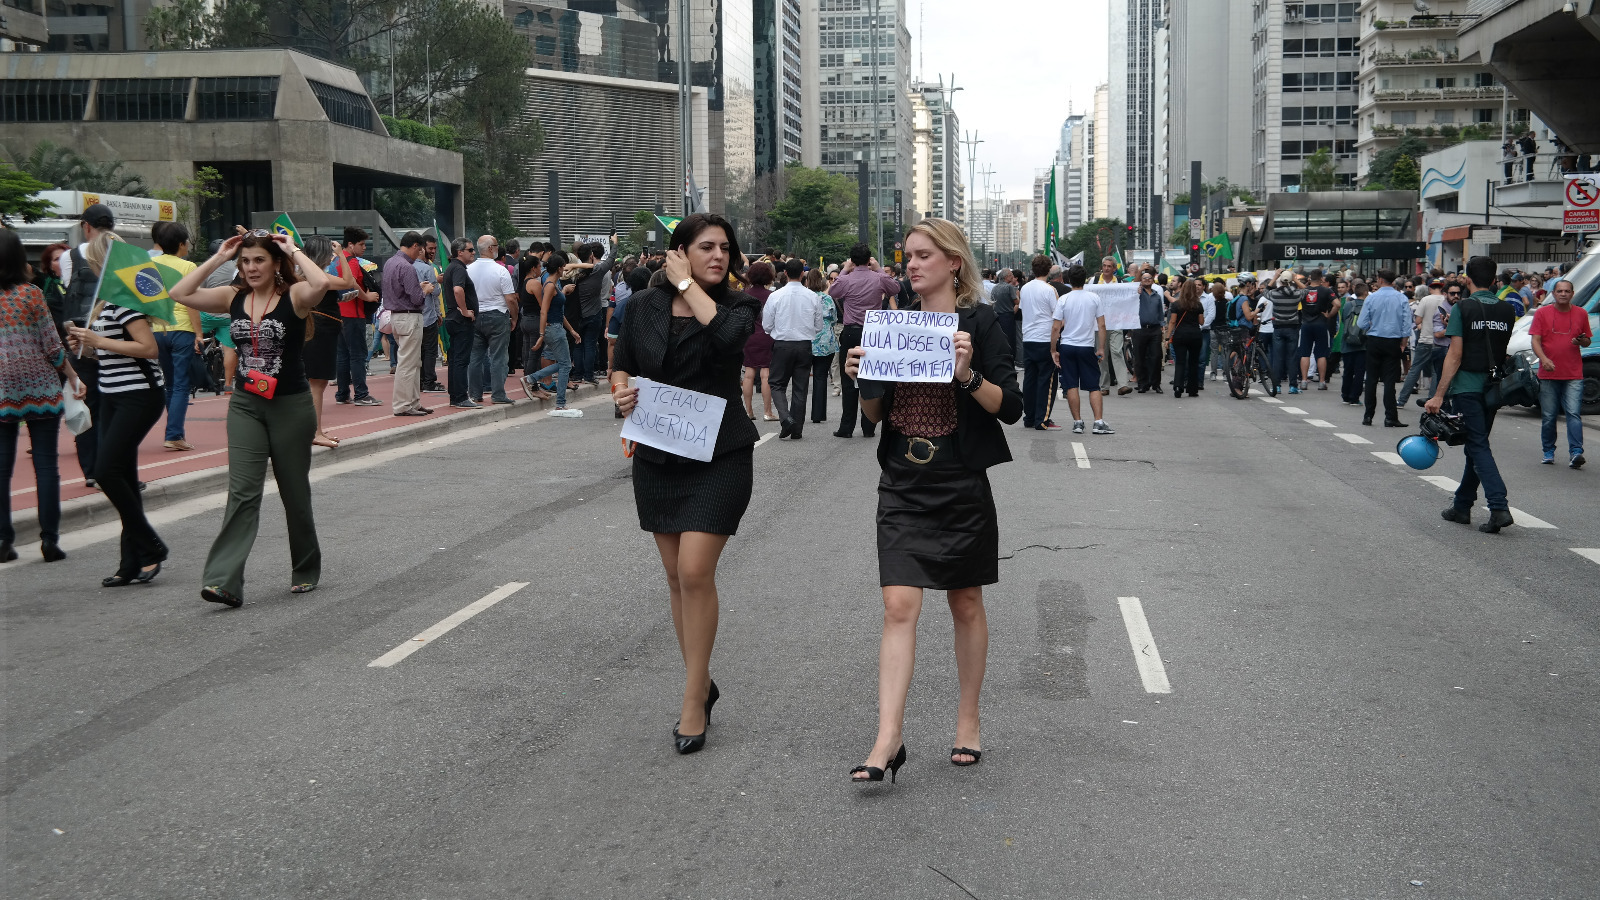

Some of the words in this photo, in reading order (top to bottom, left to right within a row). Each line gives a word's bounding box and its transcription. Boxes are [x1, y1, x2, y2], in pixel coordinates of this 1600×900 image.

[1299, 247, 1331, 255] Trianon
[1335, 247, 1359, 256] Masp
[866, 311, 904, 325] ESTADO
[1471, 320, 1508, 332] IMPRENSA
[862, 331, 892, 349] LULA
[897, 333, 934, 352] DISSE
[939, 336, 951, 354] Q
[860, 358, 905, 378] MAOMÉ
[907, 359, 928, 377] TEM
[928, 358, 953, 378] TETA
[651, 386, 708, 412] TCHAU
[630, 406, 708, 448] QUERIDA
